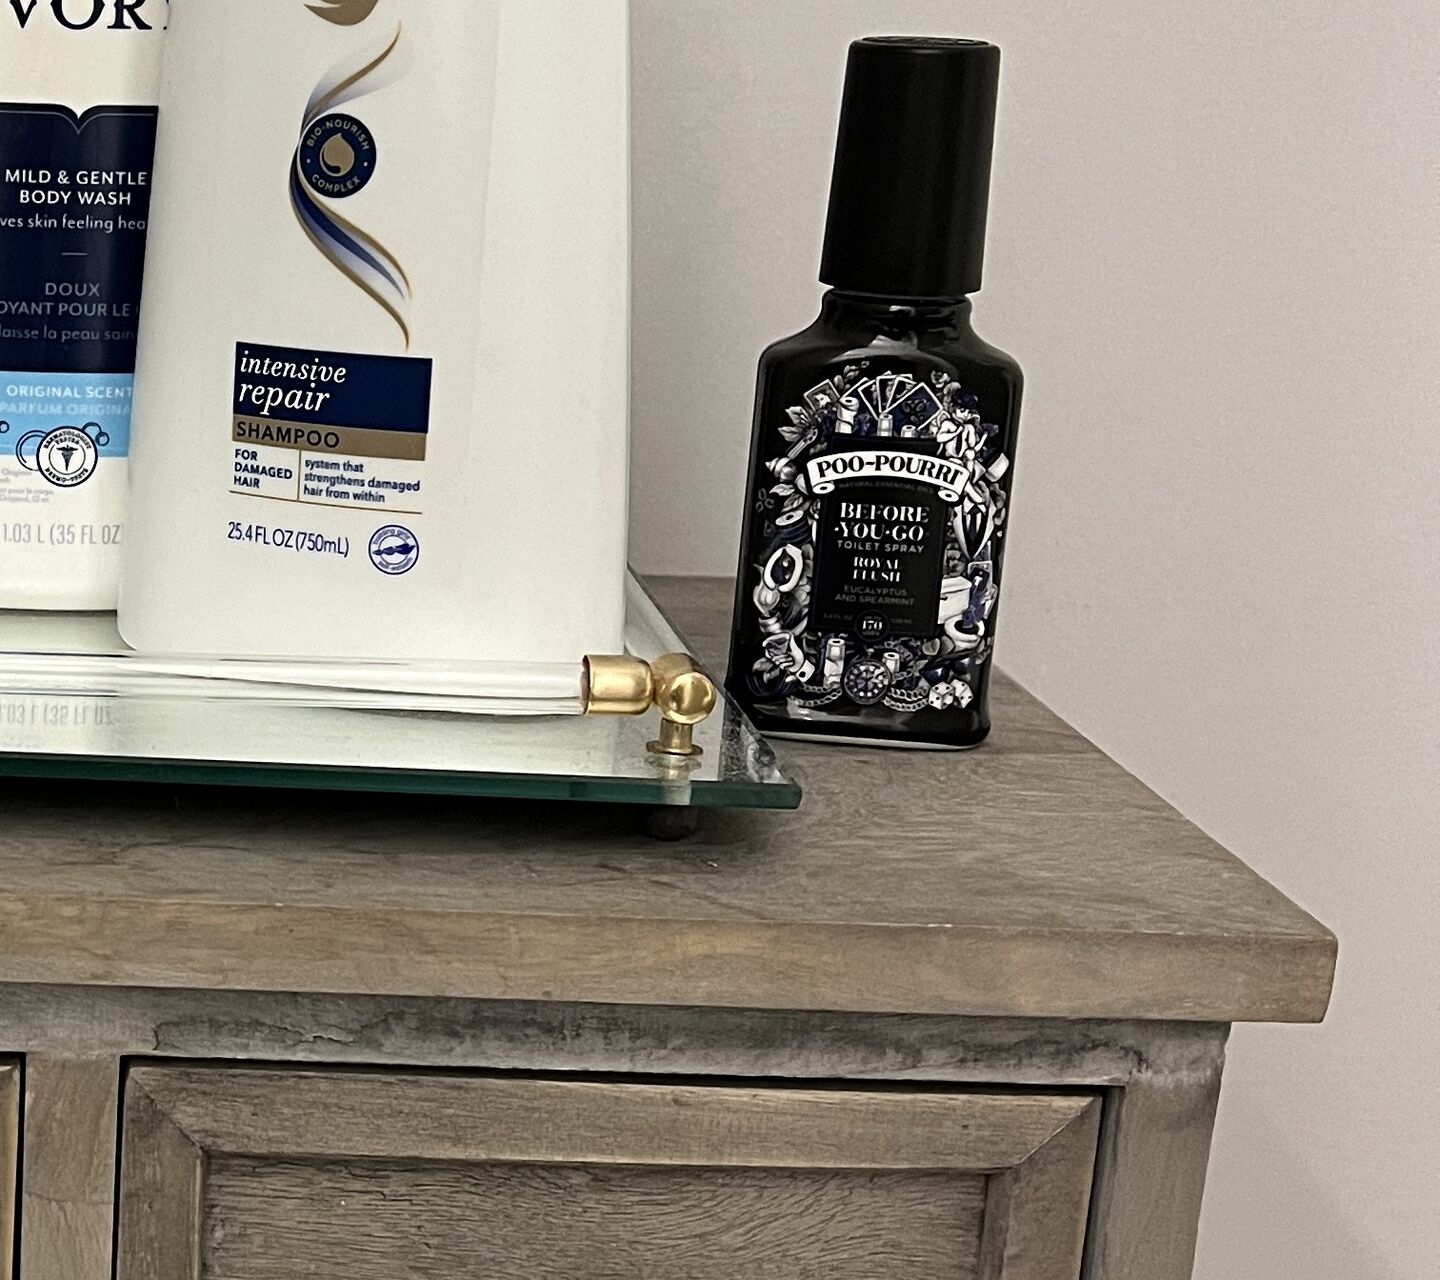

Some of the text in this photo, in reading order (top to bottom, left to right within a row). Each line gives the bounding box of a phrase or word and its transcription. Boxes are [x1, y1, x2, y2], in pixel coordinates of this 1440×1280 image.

[306, 119, 370, 151] BIO-NOURISH
[5, 169, 148, 186] MILD & GENTLE
[312, 174, 360, 193] COMPLEX
[19, 190, 132, 206] BODY WASH
[28, 212, 57, 229] skin
[62, 213, 114, 234] feeling
[45, 282, 100, 297] DOUX
[58, 302, 108, 317] POUR
[113, 303, 131, 317] LE
[43, 324, 58, 340] la
[61, 328, 100, 343] peau
[240, 350, 346, 384] intensive
[6, 384, 81, 399] ORIGINAL
[238, 382, 330, 415] repair
[236, 421, 340, 449] SHAMPOO
[235, 448, 258, 462] FOR
[234, 462, 292, 480] DAMAGED
[305, 459, 364, 473] system that
[816, 455, 964, 487] POO-POURRI
[233, 475, 260, 489] HAIR
[304, 473, 420, 493] strengthens damaged
[303, 486, 385, 503] hair from within
[840, 502, 930, 523] BEFORE
[3, 523, 31, 543] 1.03
[37, 524, 45, 544] L
[50, 523, 75, 546] (35
[80, 524, 97, 545] FL
[227, 521, 253, 542] 25.4
[255, 526, 270, 545] FL
[272, 528, 293, 548] OZ
[837, 540, 924, 554] TOILET SPRAY
[854, 556, 900, 570] ROYAL
[844, 584, 907, 596] EUCALYPTUS
[835, 593, 915, 606] AND SPEARMINT
